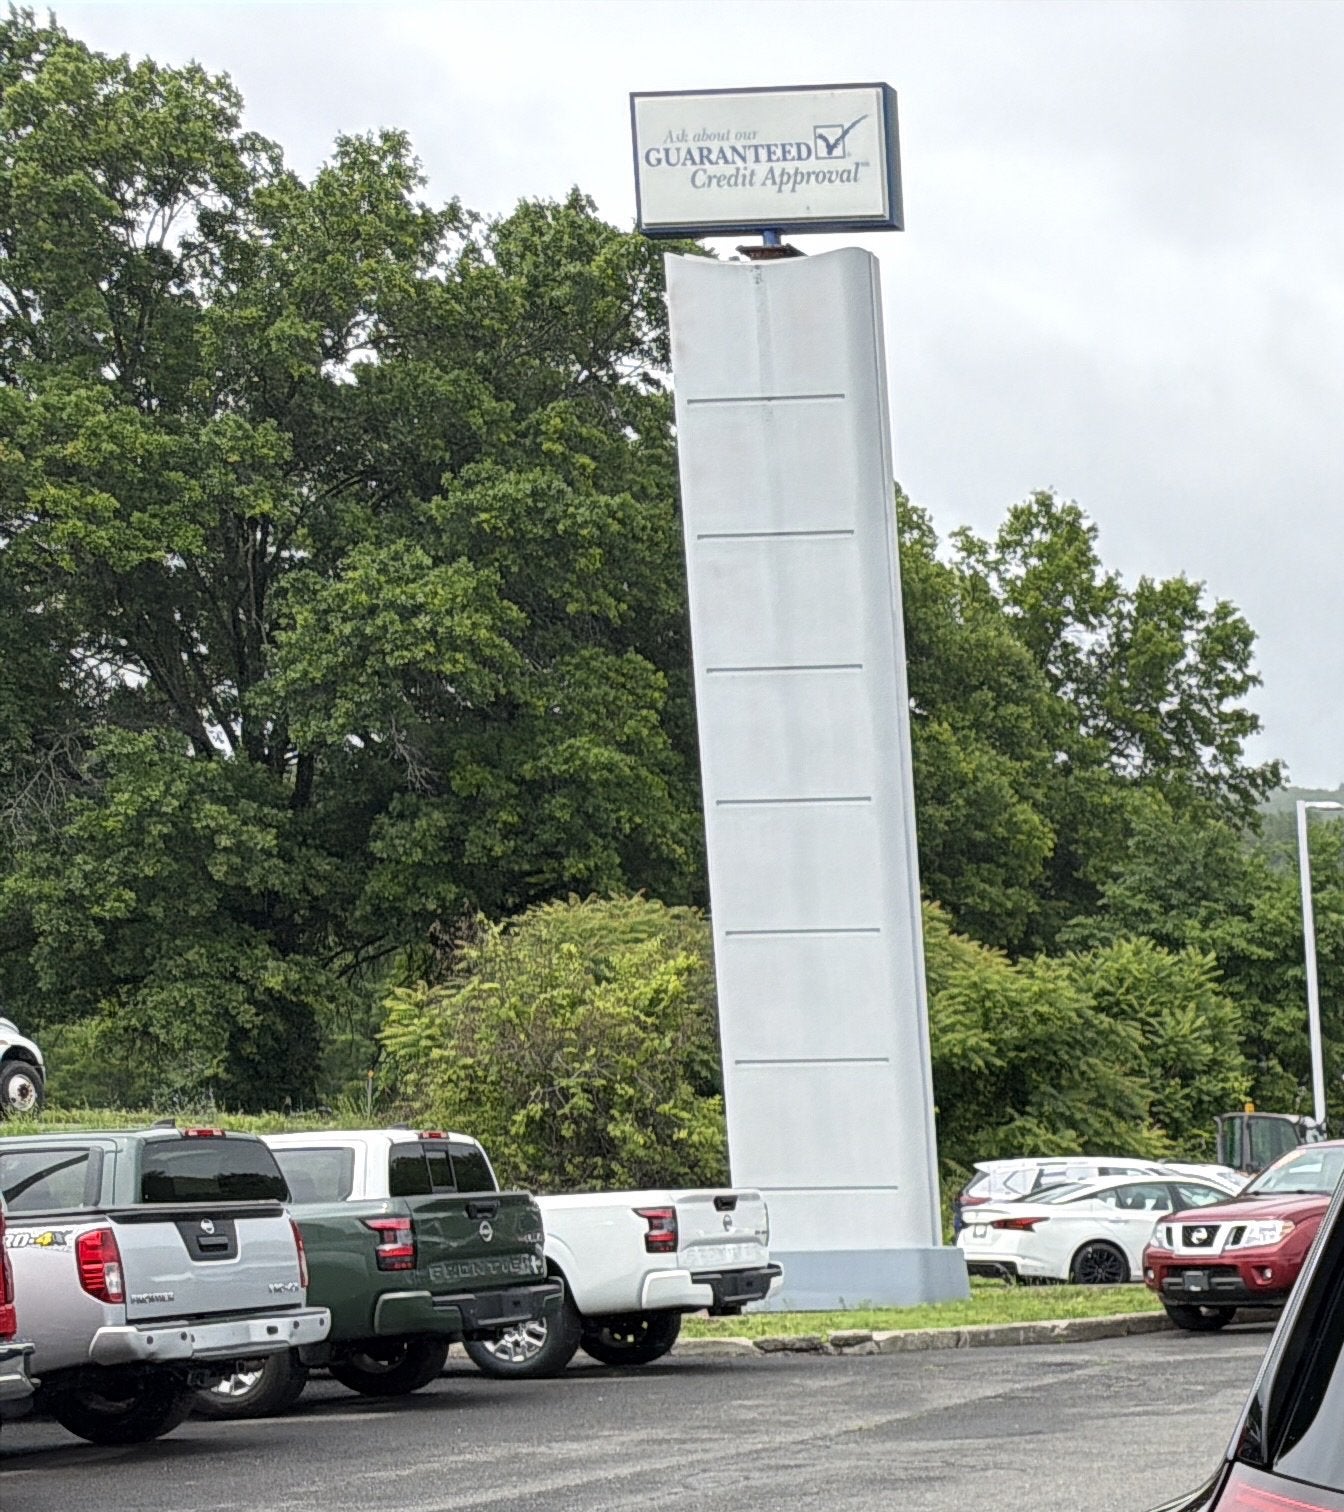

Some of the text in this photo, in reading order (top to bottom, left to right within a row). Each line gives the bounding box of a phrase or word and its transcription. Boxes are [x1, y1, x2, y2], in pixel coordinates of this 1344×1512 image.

[663, 127, 758, 144] Ask about our
[644, 142, 812, 167] GUARANTEED
[690, 161, 860, 193] Credit Approval
